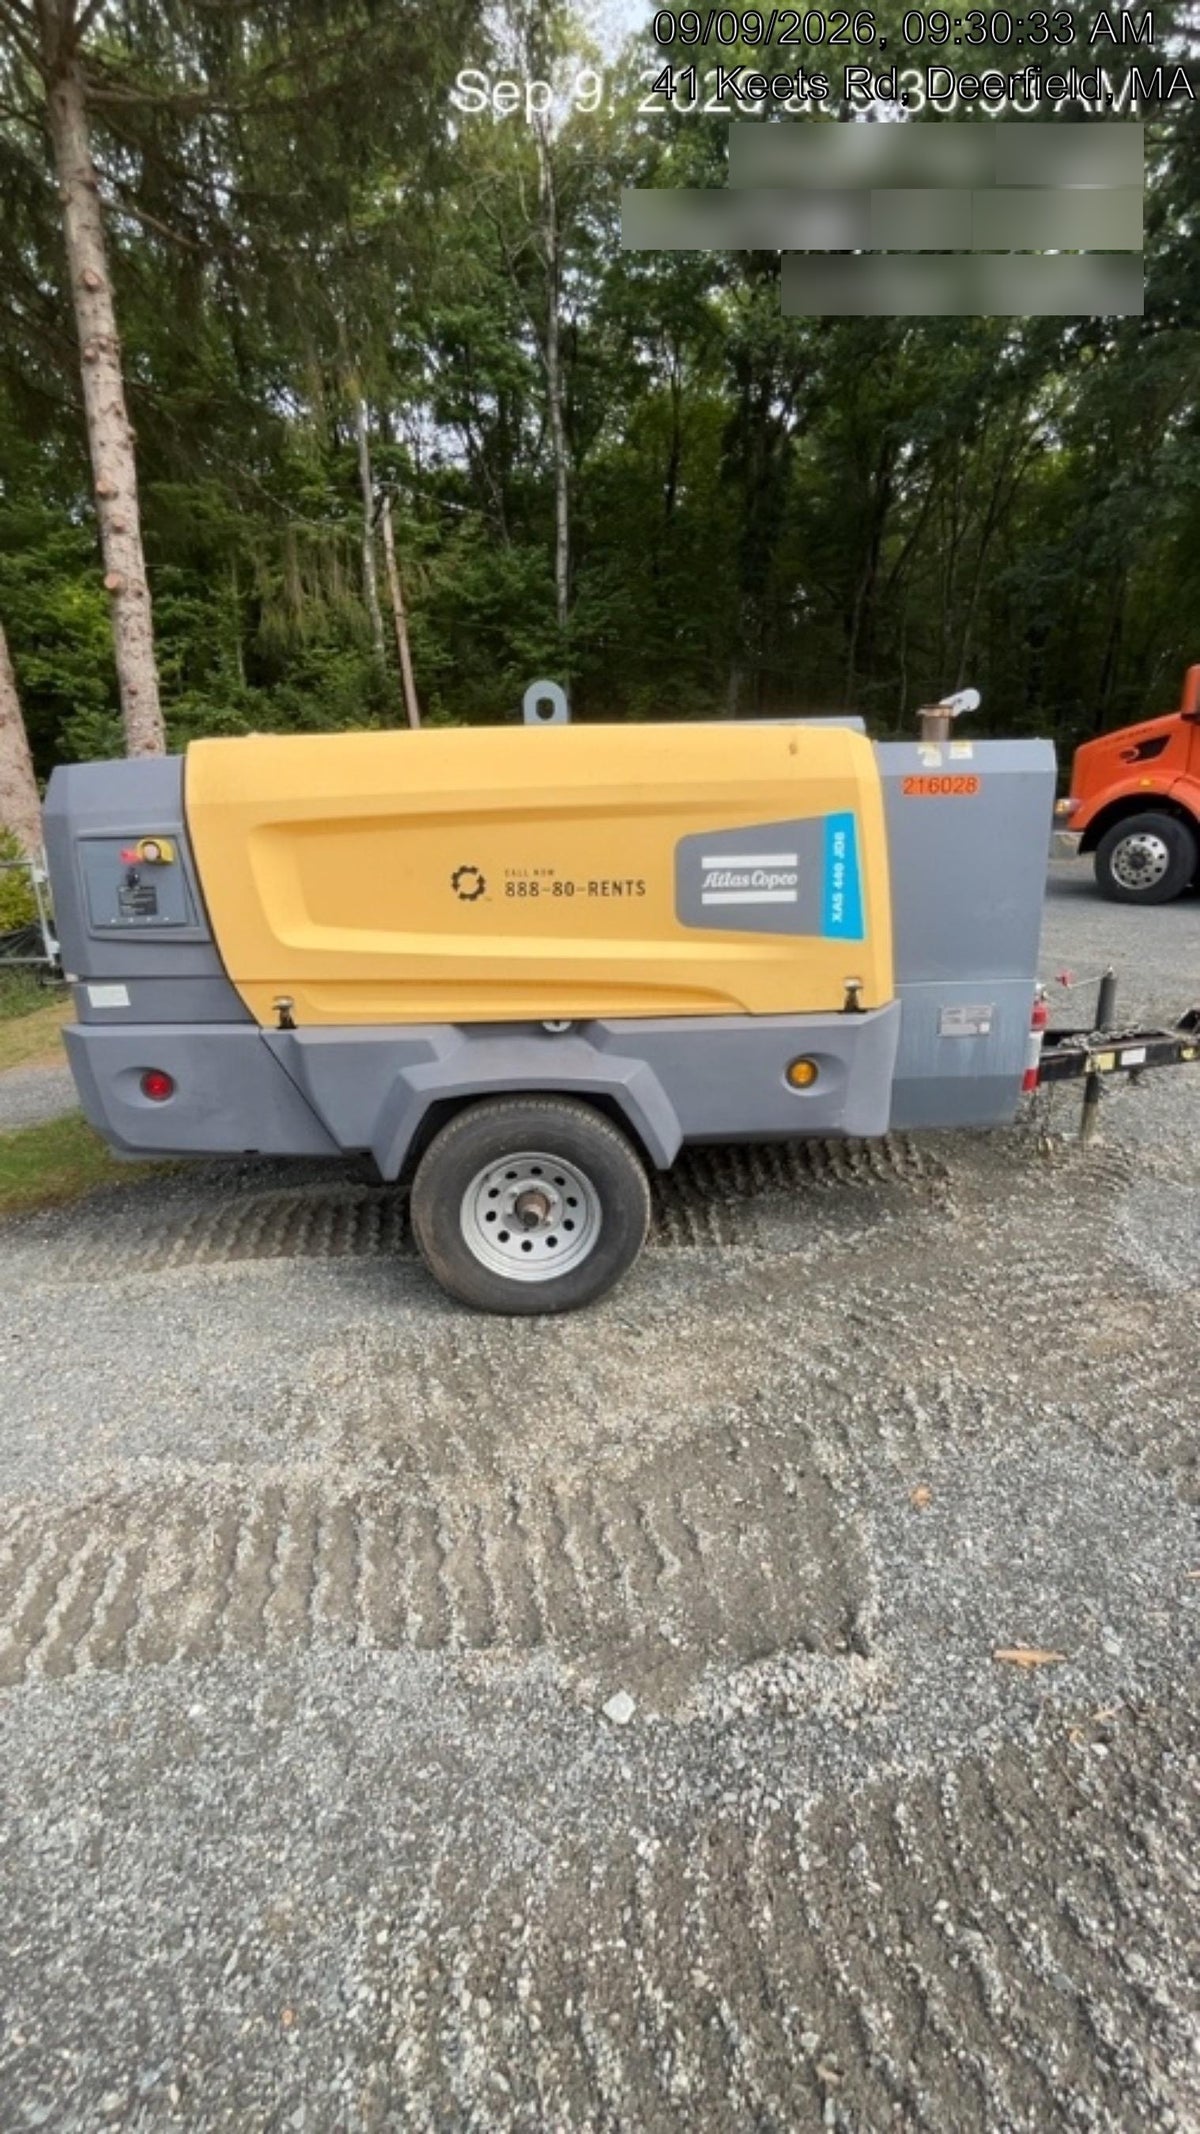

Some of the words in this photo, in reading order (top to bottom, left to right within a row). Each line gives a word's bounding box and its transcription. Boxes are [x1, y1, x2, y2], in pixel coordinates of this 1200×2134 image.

[903, 776, 979, 795] 216028
[505, 869, 528, 878] CALL
[533, 868, 555, 877] NOW
[702, 871, 750, 889] Atlas
[751, 869, 799, 890] Copco
[504, 879, 647, 898] 888-80-RENTS
[831, 892, 844, 924] XAS
